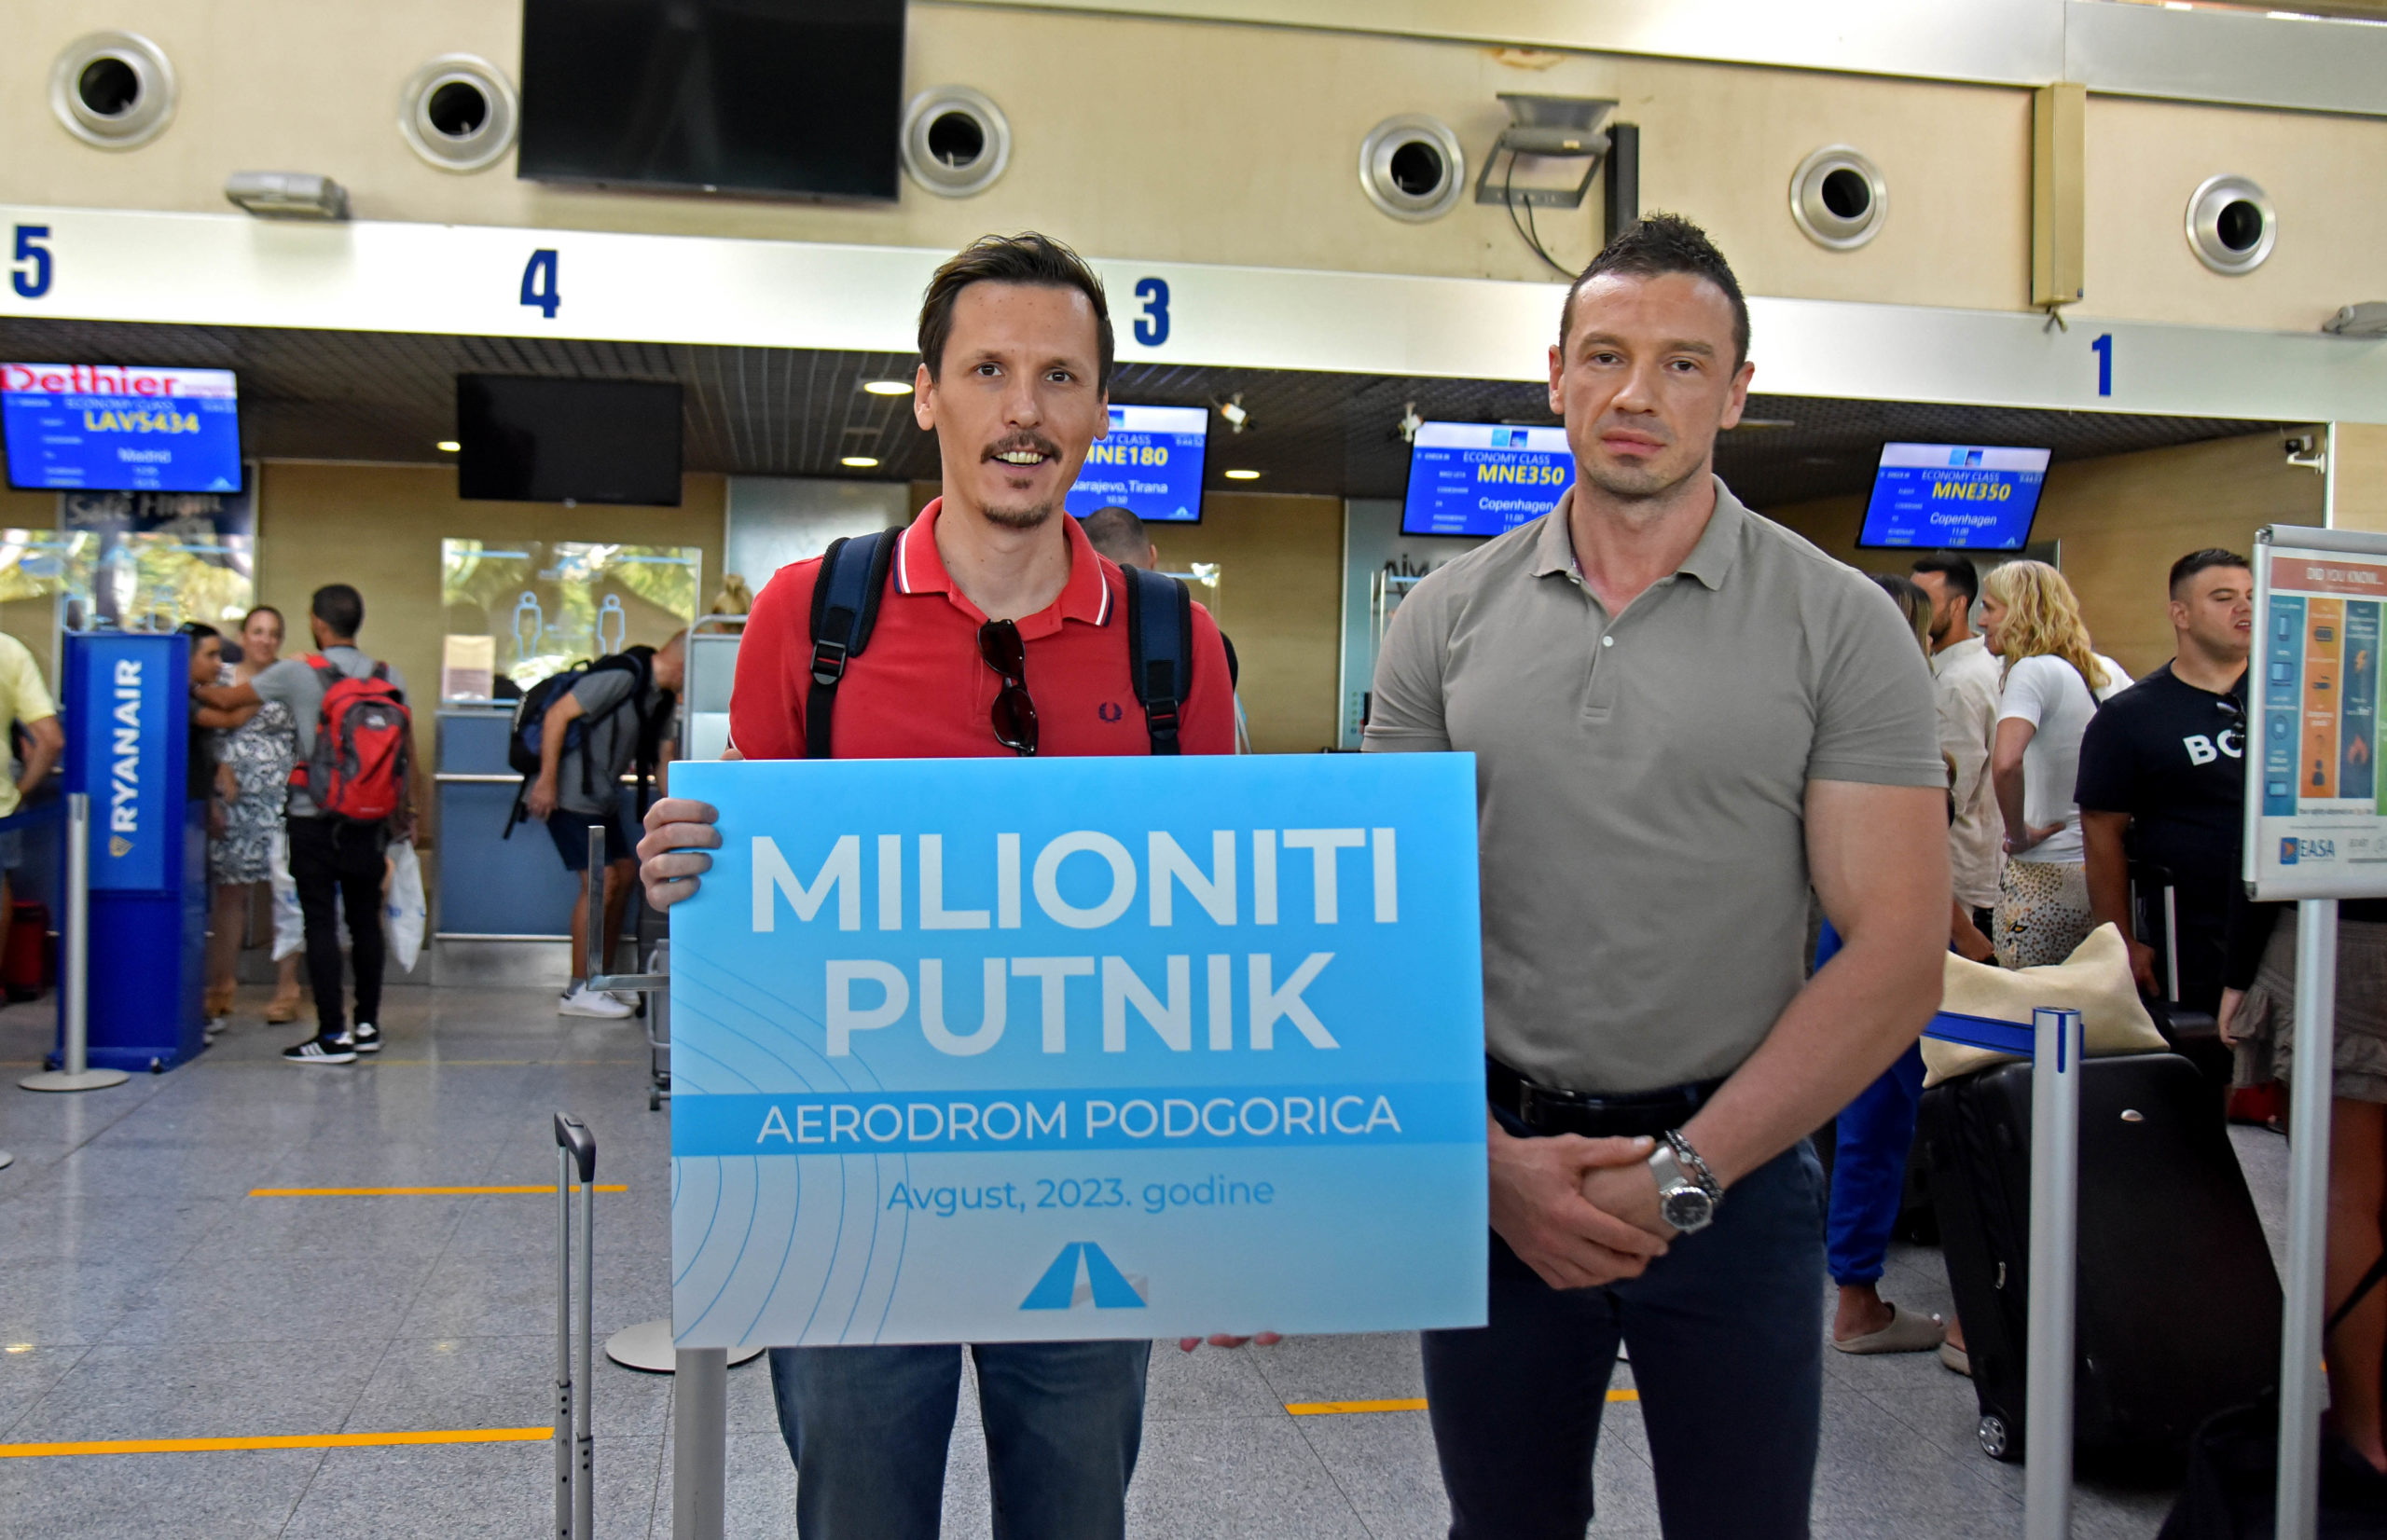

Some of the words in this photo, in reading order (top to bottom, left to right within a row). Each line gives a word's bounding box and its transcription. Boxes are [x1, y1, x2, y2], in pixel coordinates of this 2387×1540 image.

[12, 225, 52, 298] 5
[519, 249, 560, 318] 4
[1134, 277, 1170, 347] 3
[2091, 334, 2112, 396] 1
[1117, 433, 1152, 446] CLASS
[1462, 451, 1517, 464] ECONOMY
[1519, 454, 1551, 465] CLASS
[1477, 463, 1566, 485] MNE350
[1128, 480, 1168, 494] Tirana
[1921, 470, 1970, 482] ECONOMY
[1971, 472, 2001, 483] CLASS
[1932, 481, 2012, 502] MNE350
[1479, 496, 1554, 514] Copenhagen
[1929, 512, 1997, 528] Copenhagen
[110, 658, 143, 832] RYANAIR
[2299, 839, 2336, 858] EASA
[751, 827, 1400, 933] MILIONITI
[825, 952, 1342, 1057] PUTNIK
[756, 1102, 1068, 1145] AERODROM
[1085, 1094, 1402, 1140] PODGORICA
[887, 1180, 1027, 1217] Avgust,
[1035, 1177, 1133, 1210] 2023.
[1142, 1175, 1276, 1215] godine
